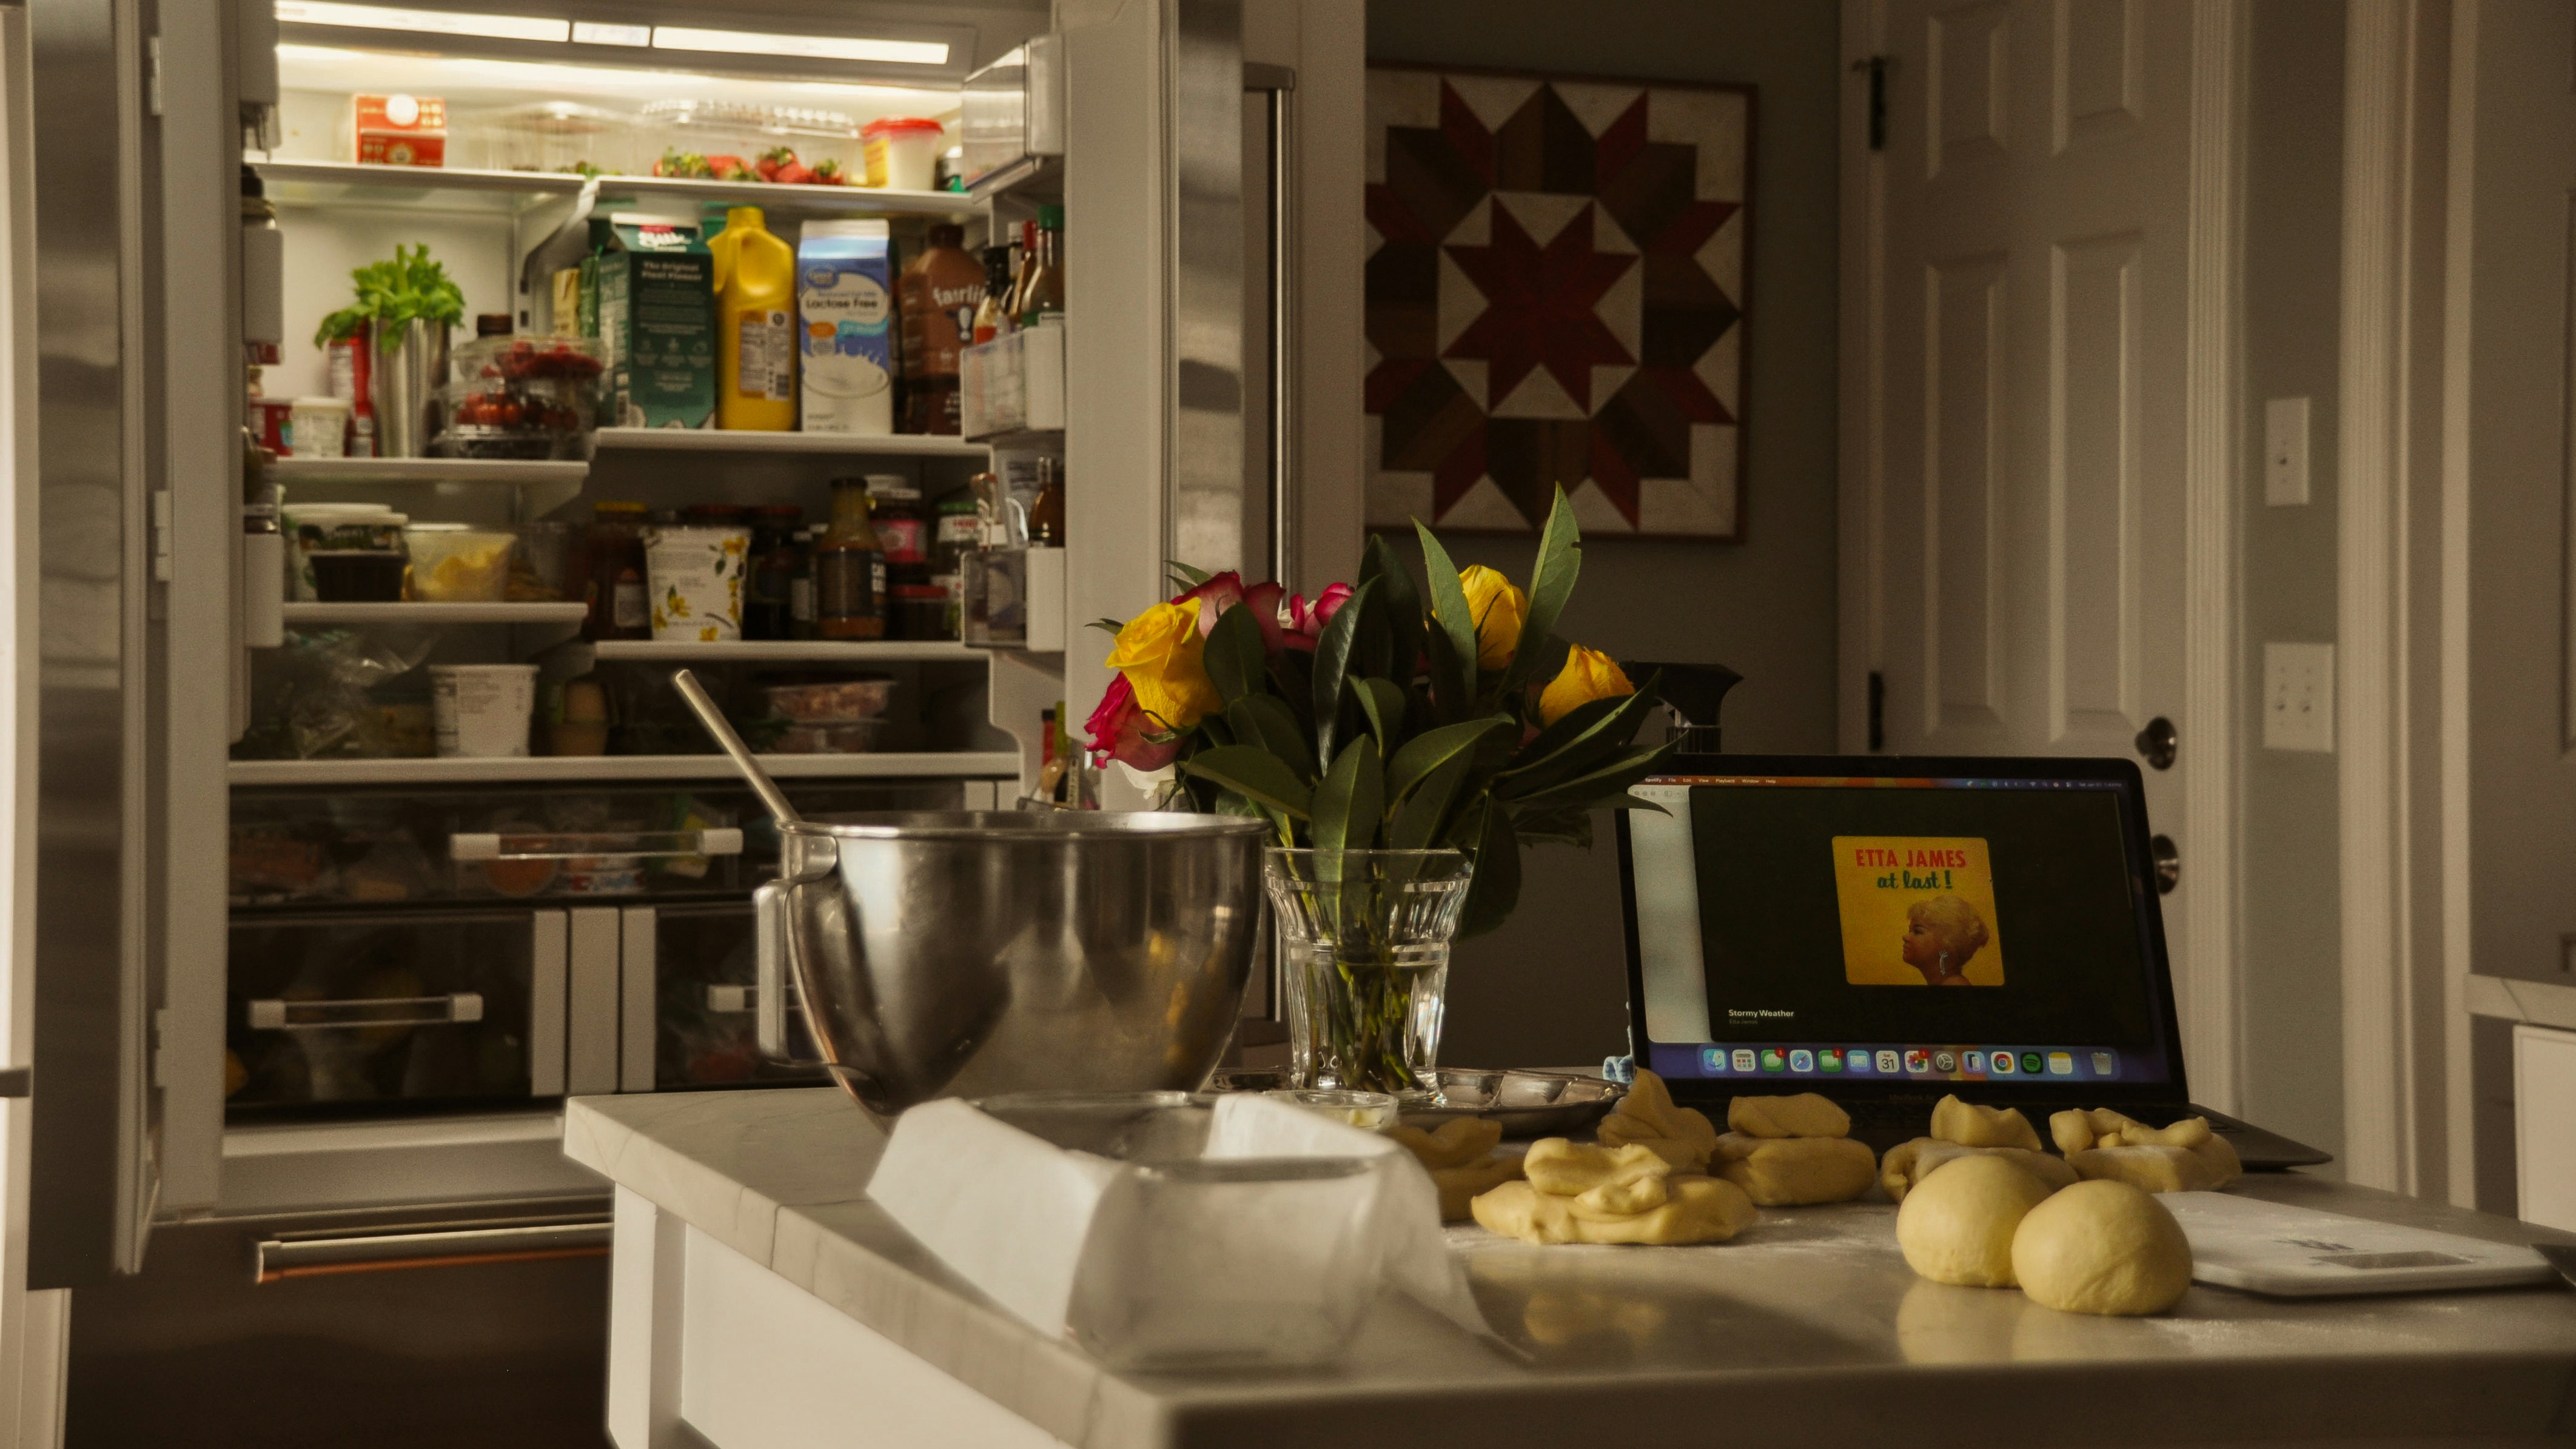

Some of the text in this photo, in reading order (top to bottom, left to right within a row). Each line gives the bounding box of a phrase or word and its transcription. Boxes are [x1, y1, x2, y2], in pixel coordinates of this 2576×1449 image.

[806, 297, 877, 308] Lactose Free
[1856, 849, 1967, 868] ETTA JAMES
[1877, 872, 1899, 889] at
[1728, 1009, 1759, 1018] Stormy
[1881, 1059, 1895, 1069] 31
